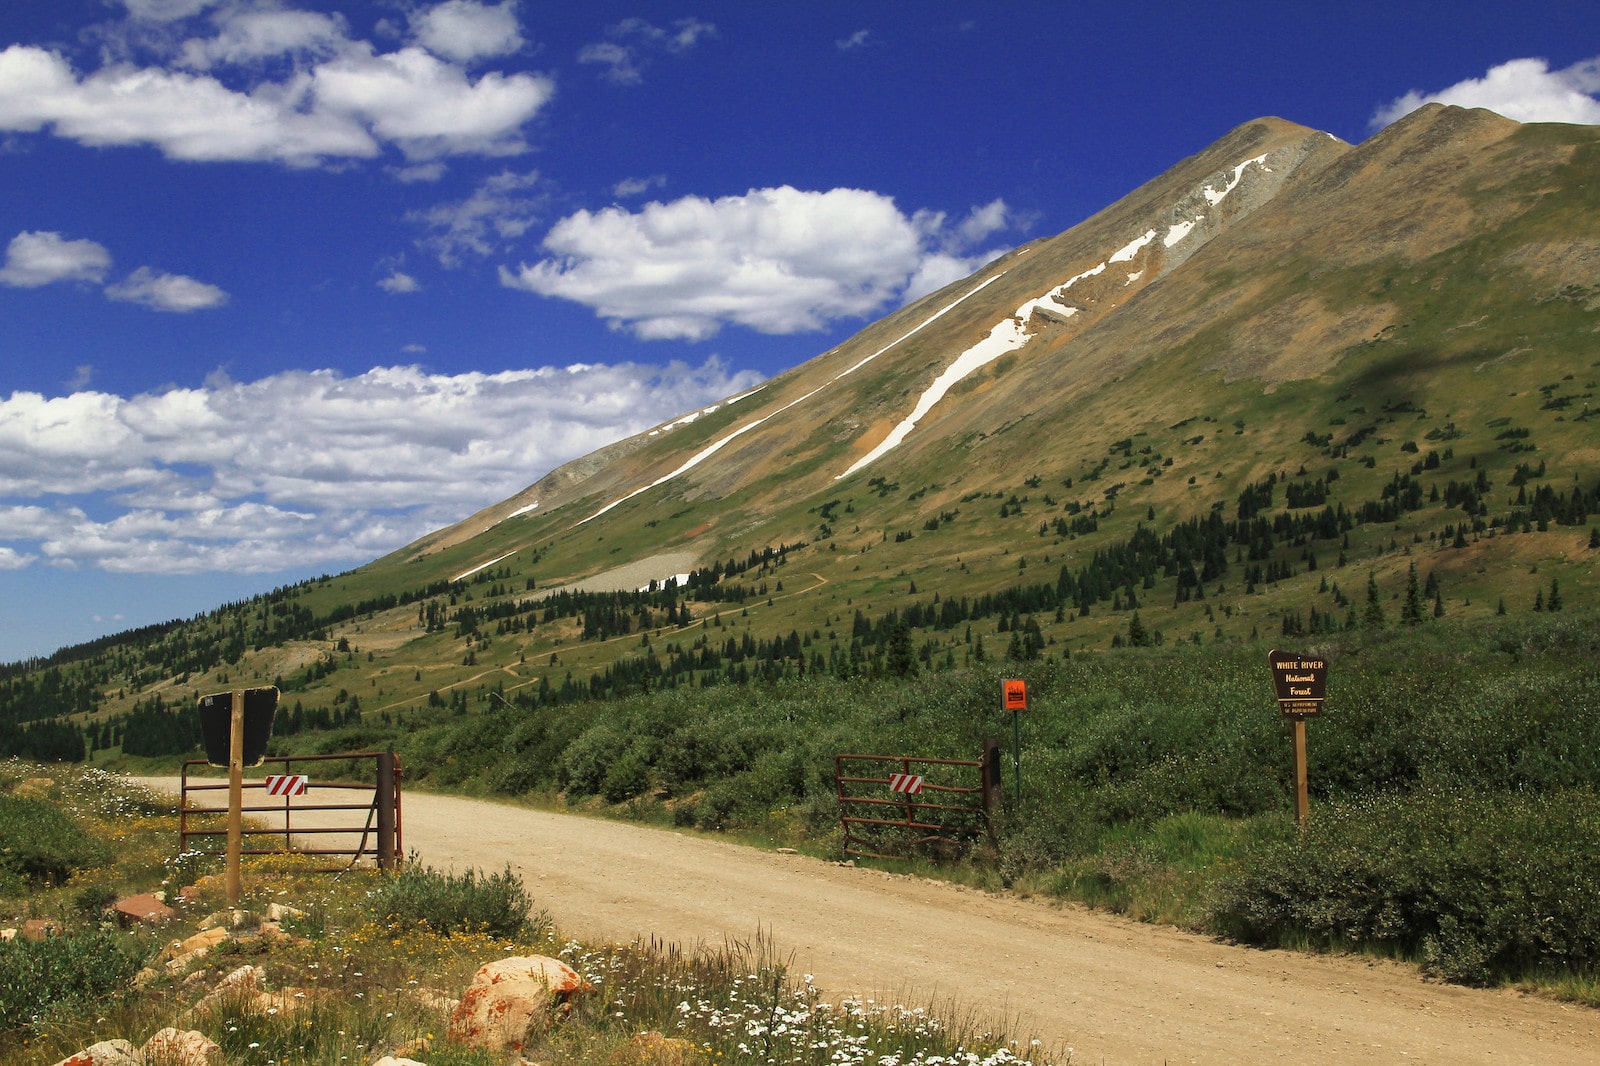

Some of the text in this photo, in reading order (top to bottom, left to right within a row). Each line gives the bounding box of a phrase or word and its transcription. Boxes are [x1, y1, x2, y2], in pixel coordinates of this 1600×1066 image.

[1276, 661, 1323, 669] WHITE RIVER
[1285, 673, 1315, 682] National
[1290, 686, 1311, 696] Forest
